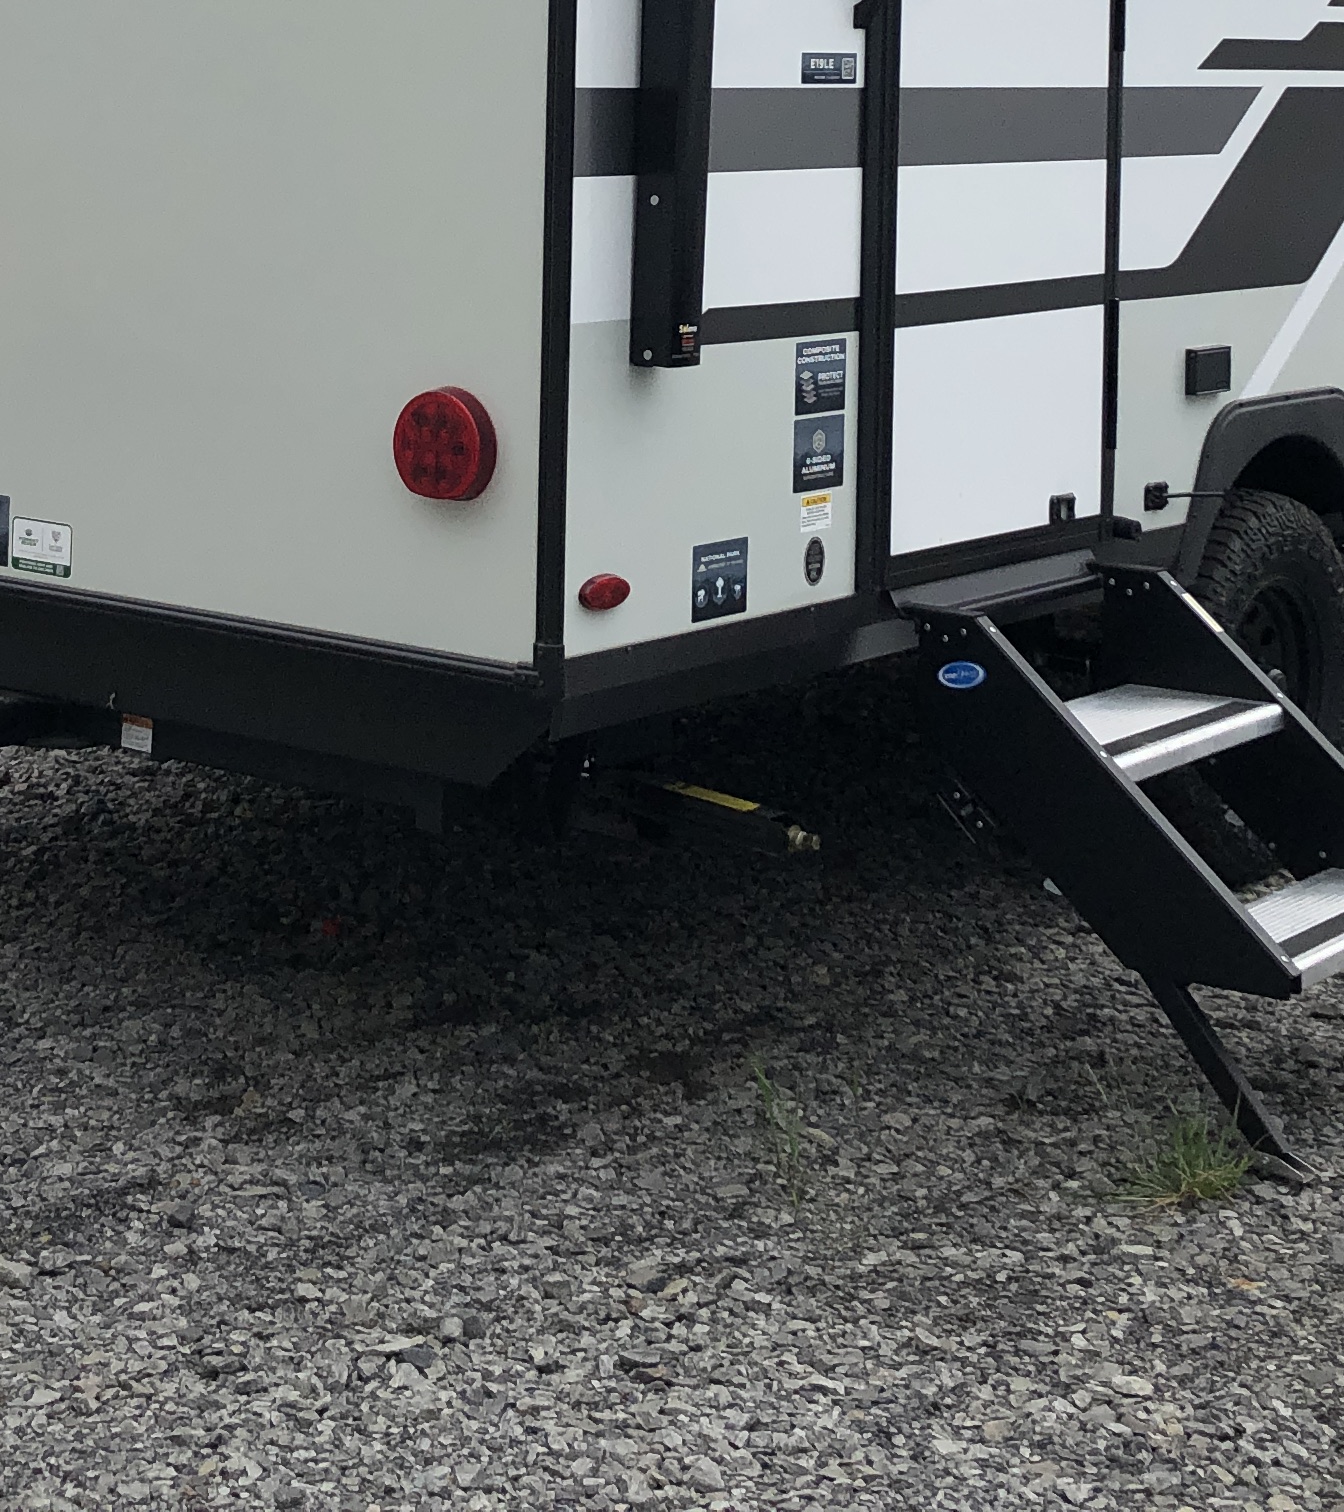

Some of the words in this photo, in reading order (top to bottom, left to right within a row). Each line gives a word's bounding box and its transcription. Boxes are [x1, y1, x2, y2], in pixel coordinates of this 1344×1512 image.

[803, 344, 840, 355] COMPOSITE
[797, 353, 845, 364] CONSTRUCTION
[801, 462, 836, 474] ALUMINUM
[700, 553, 725, 562] NATIONAL
